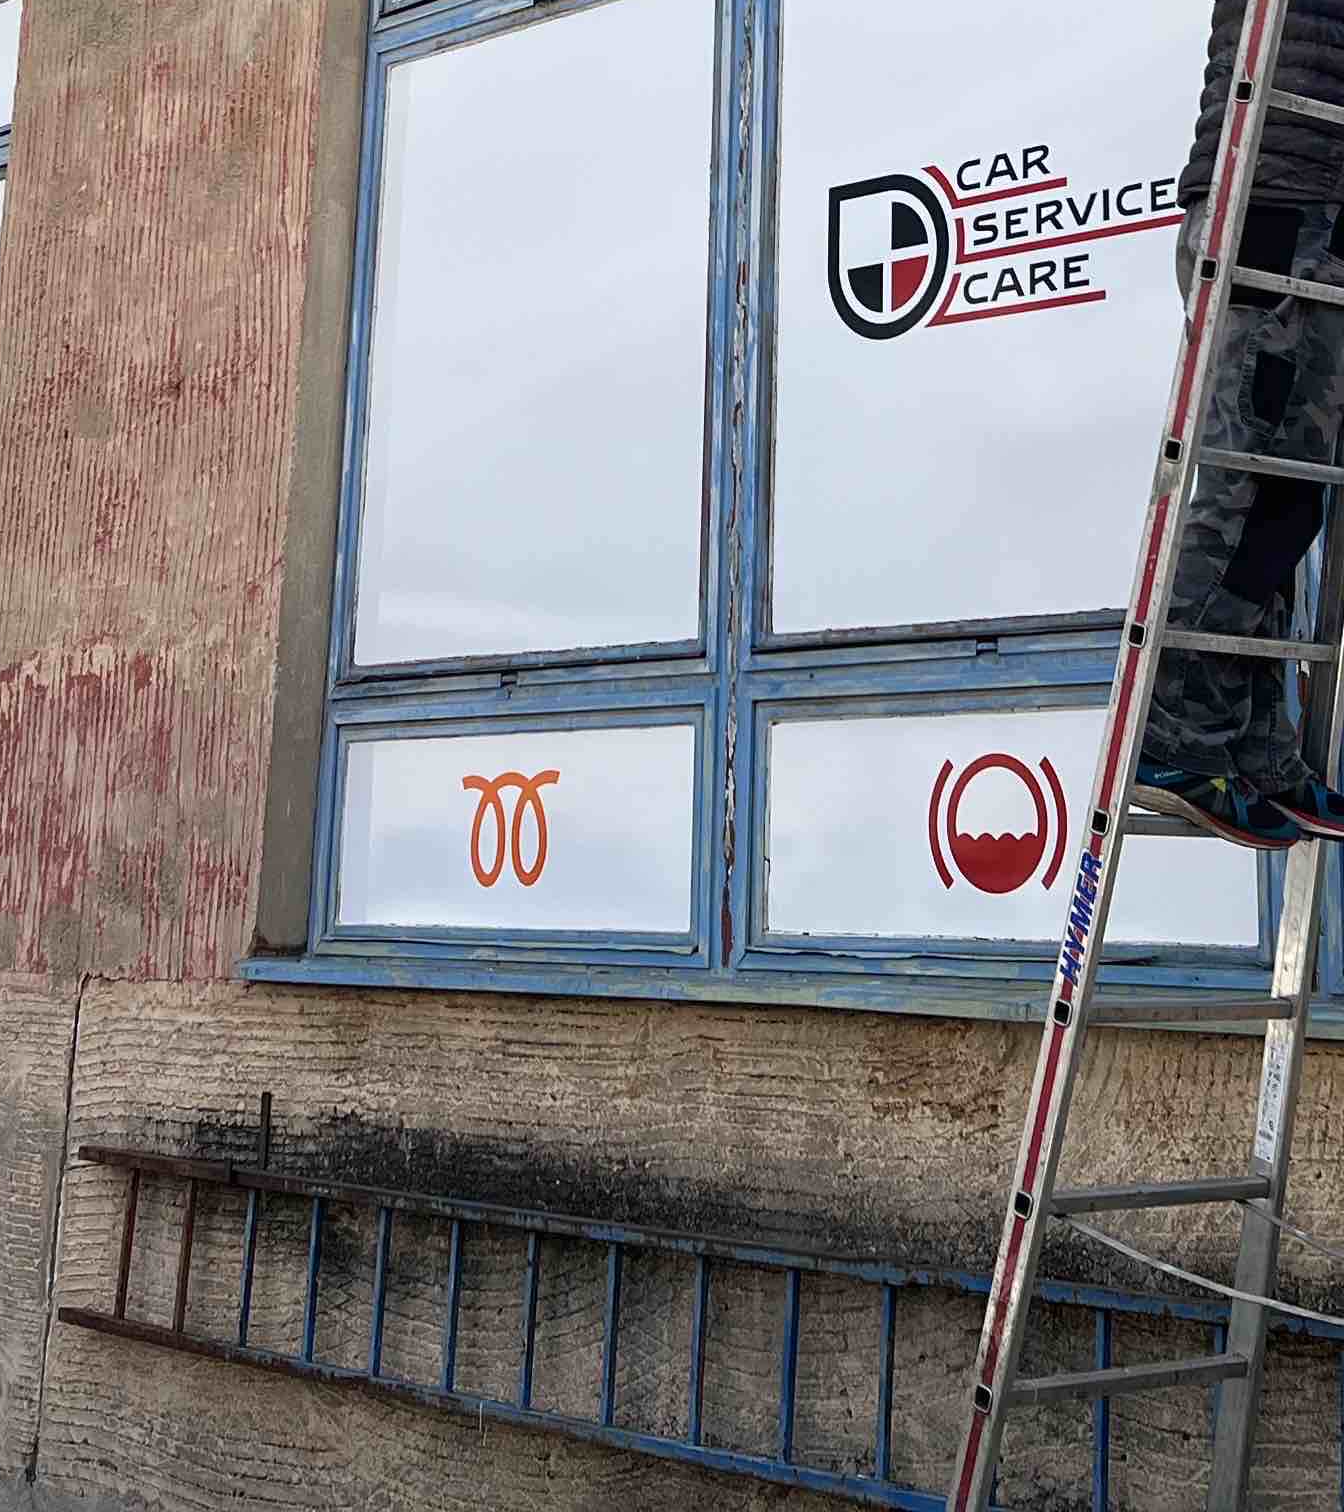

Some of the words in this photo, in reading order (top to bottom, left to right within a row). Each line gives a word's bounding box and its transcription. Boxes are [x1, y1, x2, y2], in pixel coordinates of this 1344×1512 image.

[956, 144, 1051, 191] CAR
[973, 177, 1176, 247] SERVICE
[963, 253, 1090, 305] CARE
[1059, 851, 1103, 987] HYMER
